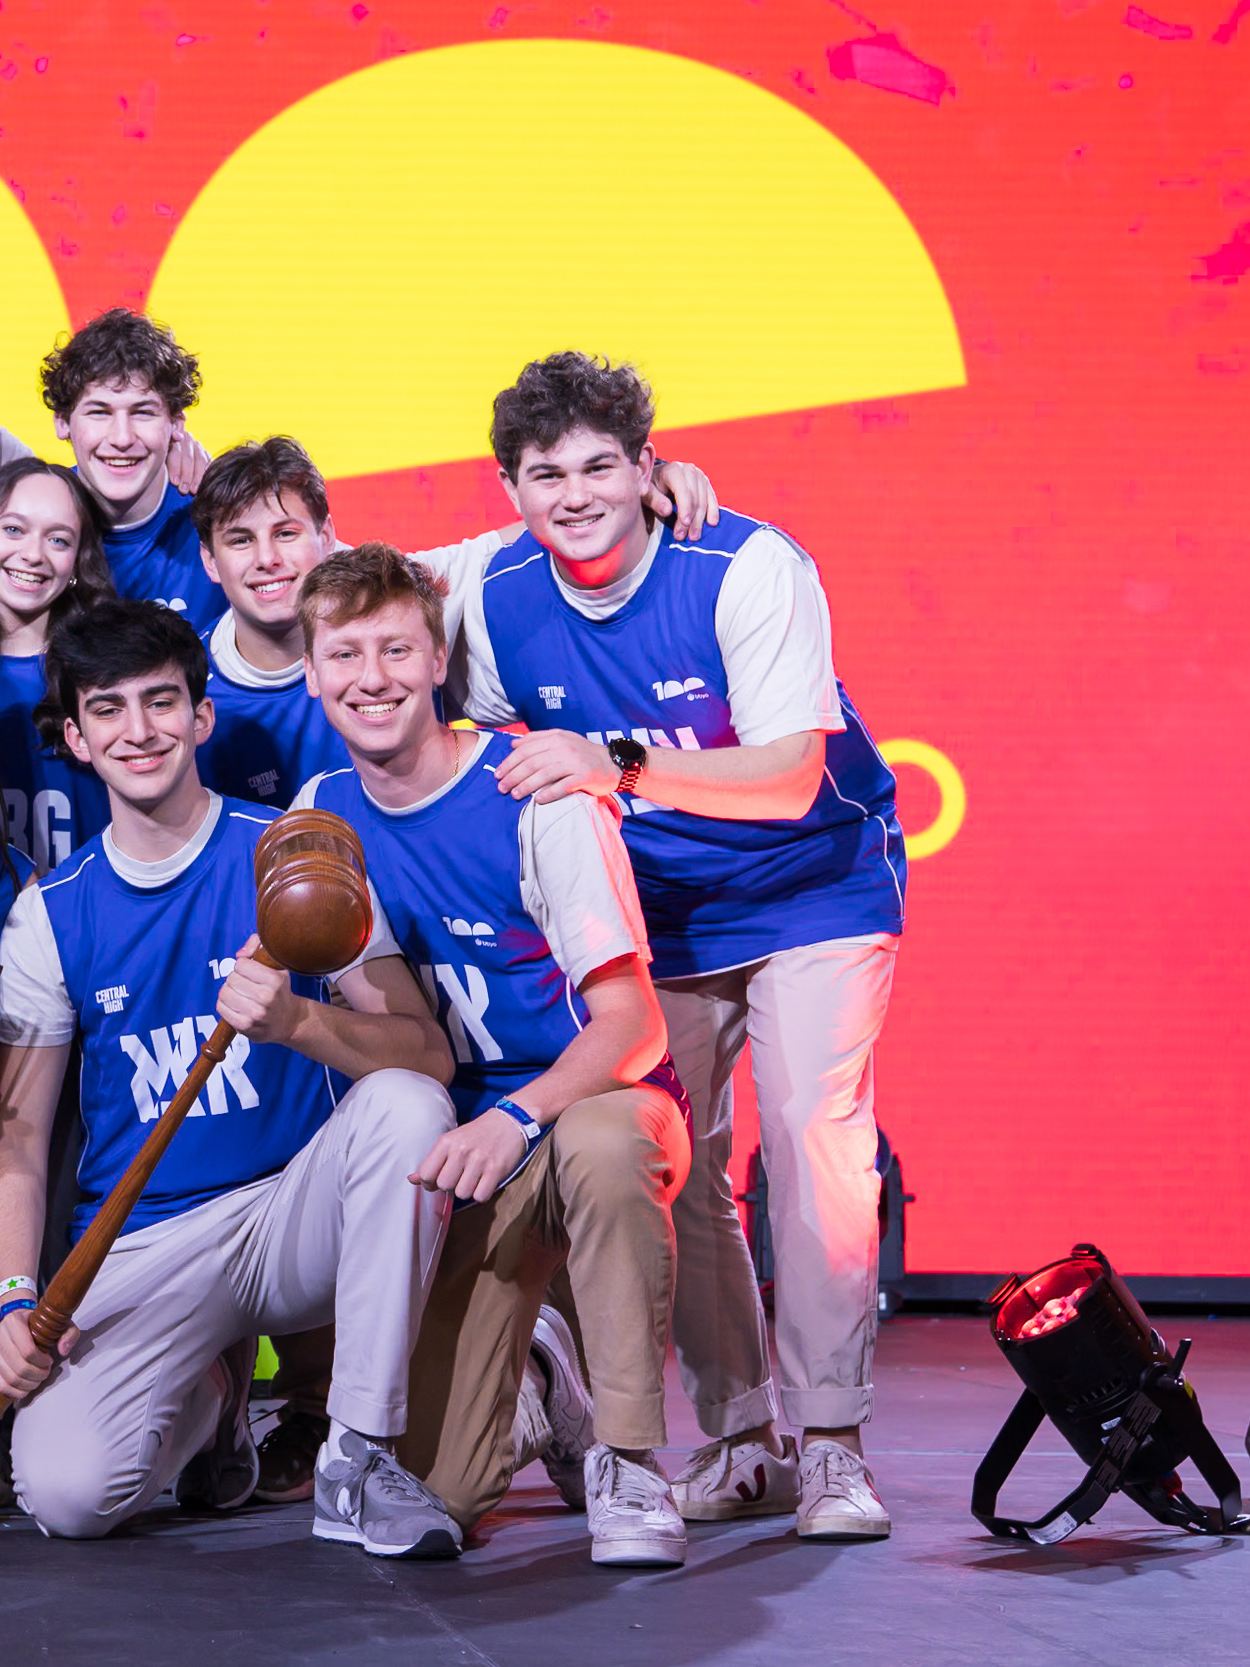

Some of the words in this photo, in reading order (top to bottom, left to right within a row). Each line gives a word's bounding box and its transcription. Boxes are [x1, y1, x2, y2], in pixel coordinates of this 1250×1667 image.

[538, 685, 567, 699] CENTRAL
[652, 676, 706, 701] 100
[248, 768, 281, 789] CENTRAL
[442, 916, 496, 936] 100
[209, 957, 237, 980] 10
[95, 984, 130, 1004] CENTRAL
